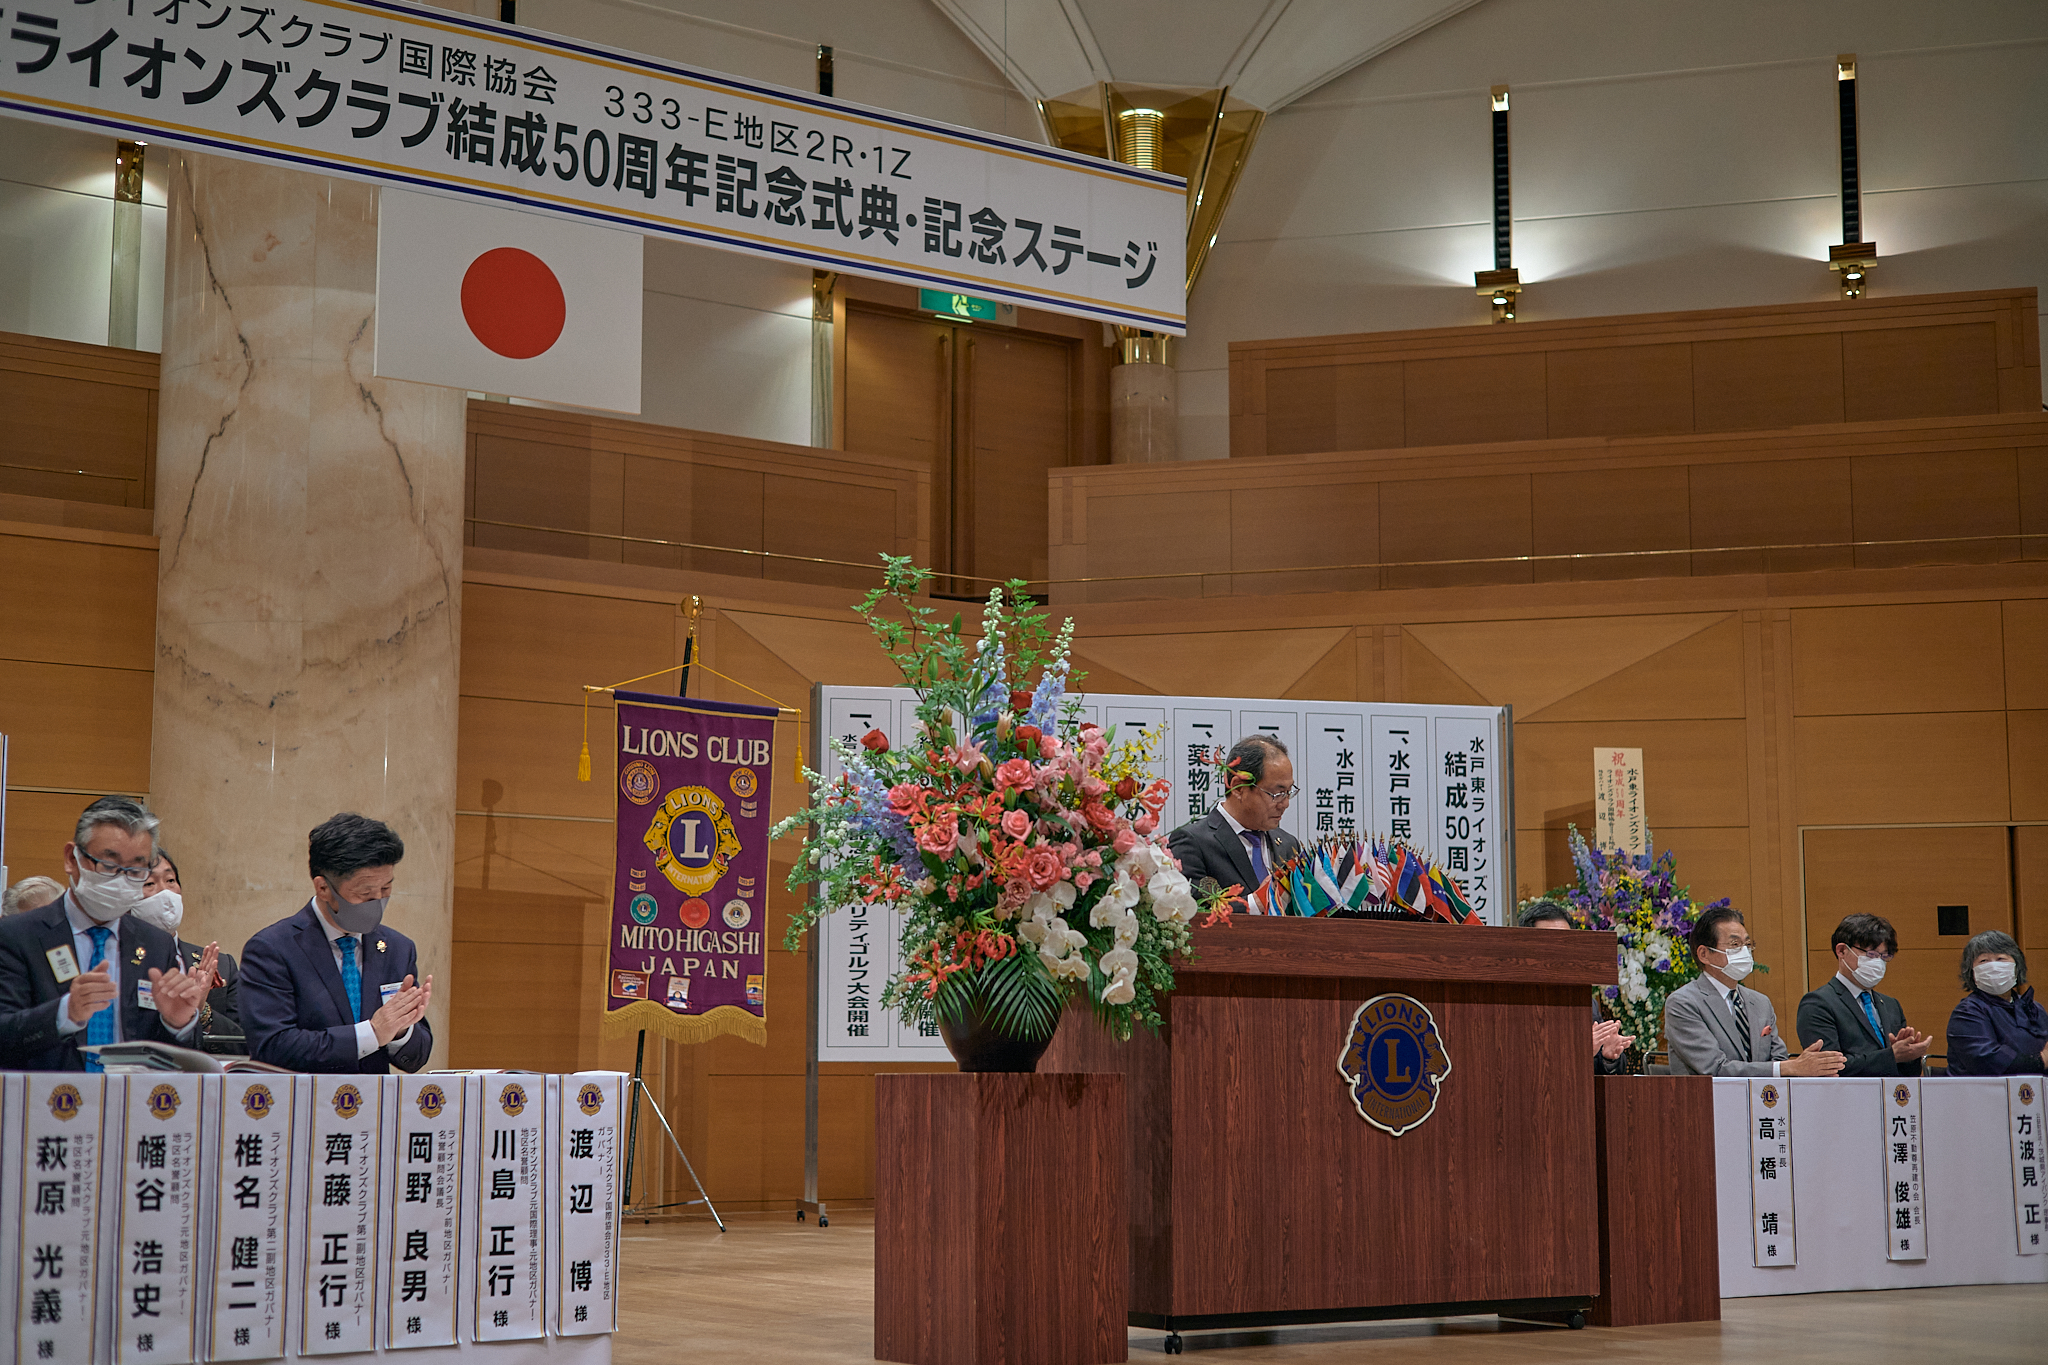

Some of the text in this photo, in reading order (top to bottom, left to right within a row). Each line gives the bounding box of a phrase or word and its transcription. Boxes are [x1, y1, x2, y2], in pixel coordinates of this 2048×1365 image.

[74, 0, 559, 104] オンズクラブ国際協会
[0, 8, 1159, 290] ライオンズクラブ結成50周年記念式典・記念ステージ
[622, 726, 771, 767] LIONS CLUB
[1187, 723, 1214, 823] 一、薬物乱
[1612, 751, 1626, 767] 祝
[670, 792, 719, 815] LIONS
[1316, 788, 1335, 842] 笠原
[1324, 727, 1356, 845] 一、水戸市笠
[1389, 730, 1412, 850] 一、水戸市民
[1627, 768, 1641, 851] 水戸東ライオンズクラブ
[680, 819, 709, 859] L
[1470, 737, 1488, 926] 水戸東ライオンズク
[641, 955, 740, 980] JAPAN
[1364, 1002, 1425, 1030] LIONS
[1383, 1038, 1412, 1083] L
[1367, 1097, 1426, 1121] INTERNATIONAL
[1777, 1116, 1787, 1168] 水戸市長
[1892, 1115, 1909, 1165] 穴澤
[135, 1134, 167, 1213] 幡谷
[169, 1133, 181, 1205] 地区名誉顧問
[234, 1133, 263, 1210] 椎名
[405, 1131, 433, 1204] 岡野
[490, 1129, 516, 1201] 川島
[265, 1132, 281, 1339] ライオンズクラブ第二副地区ガバナー
[354, 1131, 369, 1326] ライオンズクラブ第一副地区ガバナー
[443, 1130, 456, 1295] ライオンズクラブ前地区ガバナー
[1894, 1180, 1911, 1230] 俊雄
[131, 1240, 164, 1319] 浩史
[228, 1236, 259, 1310] 健二
[319, 1232, 349, 1309] 正行
[401, 1229, 429, 1303] 良男
[488, 1225, 515, 1298] 正行
[137, 1333, 154, 1353] 様
[234, 1327, 250, 1347] 様
[325, 1321, 341, 1341] 様
[407, 1316, 422, 1335] 様
[493, 1310, 508, 1328] 様
[574, 1305, 588, 1323] 様
